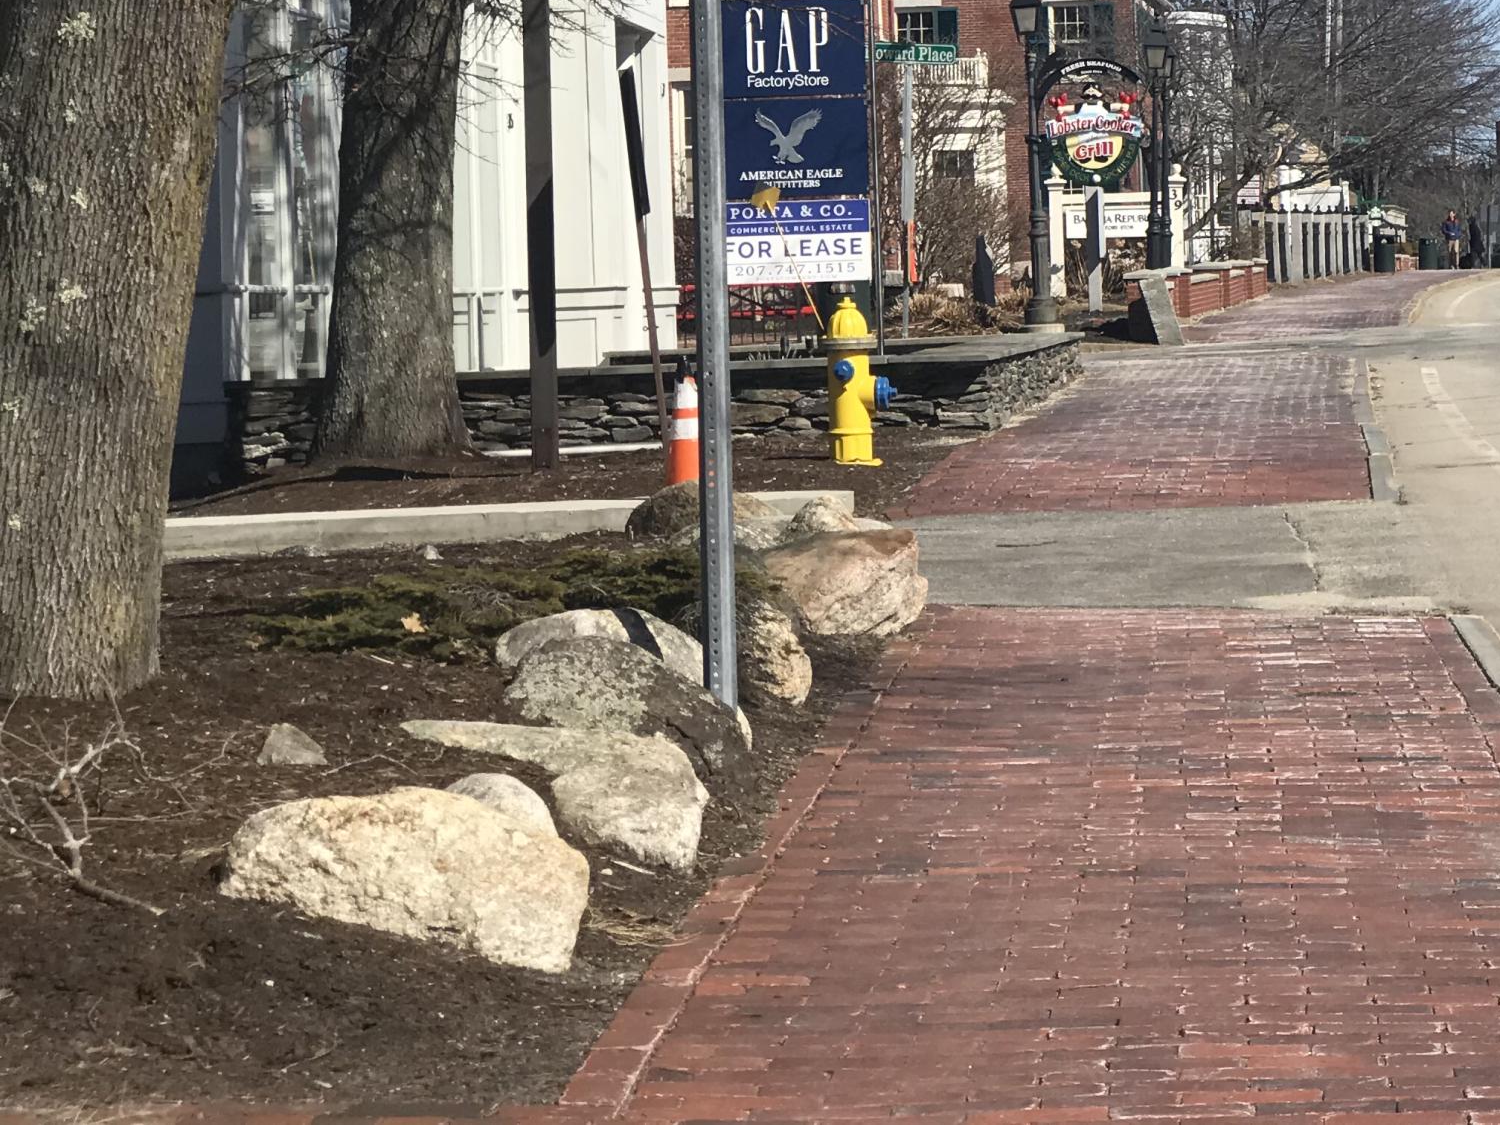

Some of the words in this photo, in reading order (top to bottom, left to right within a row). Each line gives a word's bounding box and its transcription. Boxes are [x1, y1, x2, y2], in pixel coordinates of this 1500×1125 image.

[745, 7, 828, 74] GAP
[918, 46, 953, 62] Place
[747, 74, 829, 89] FactoryStore
[1050, 119, 1094, 137] Lobster
[1095, 115, 1138, 135] Cooker
[1074, 141, 1114, 160] Grill
[739, 170, 803, 181] AMERICAN
[806, 169, 843, 179] EAGLE
[729, 207, 793, 220] PORTA
[799, 205, 812, 218] &
[819, 204, 852, 217] CO.
[730, 226, 790, 235] COMMERCIAL
[794, 225, 816, 233] REAL
[820, 223, 853, 231] ESTATE
[726, 240, 772, 259] FOR
[784, 238, 863, 257] LEASE
[735, 263, 856, 277] 207.747.1515
